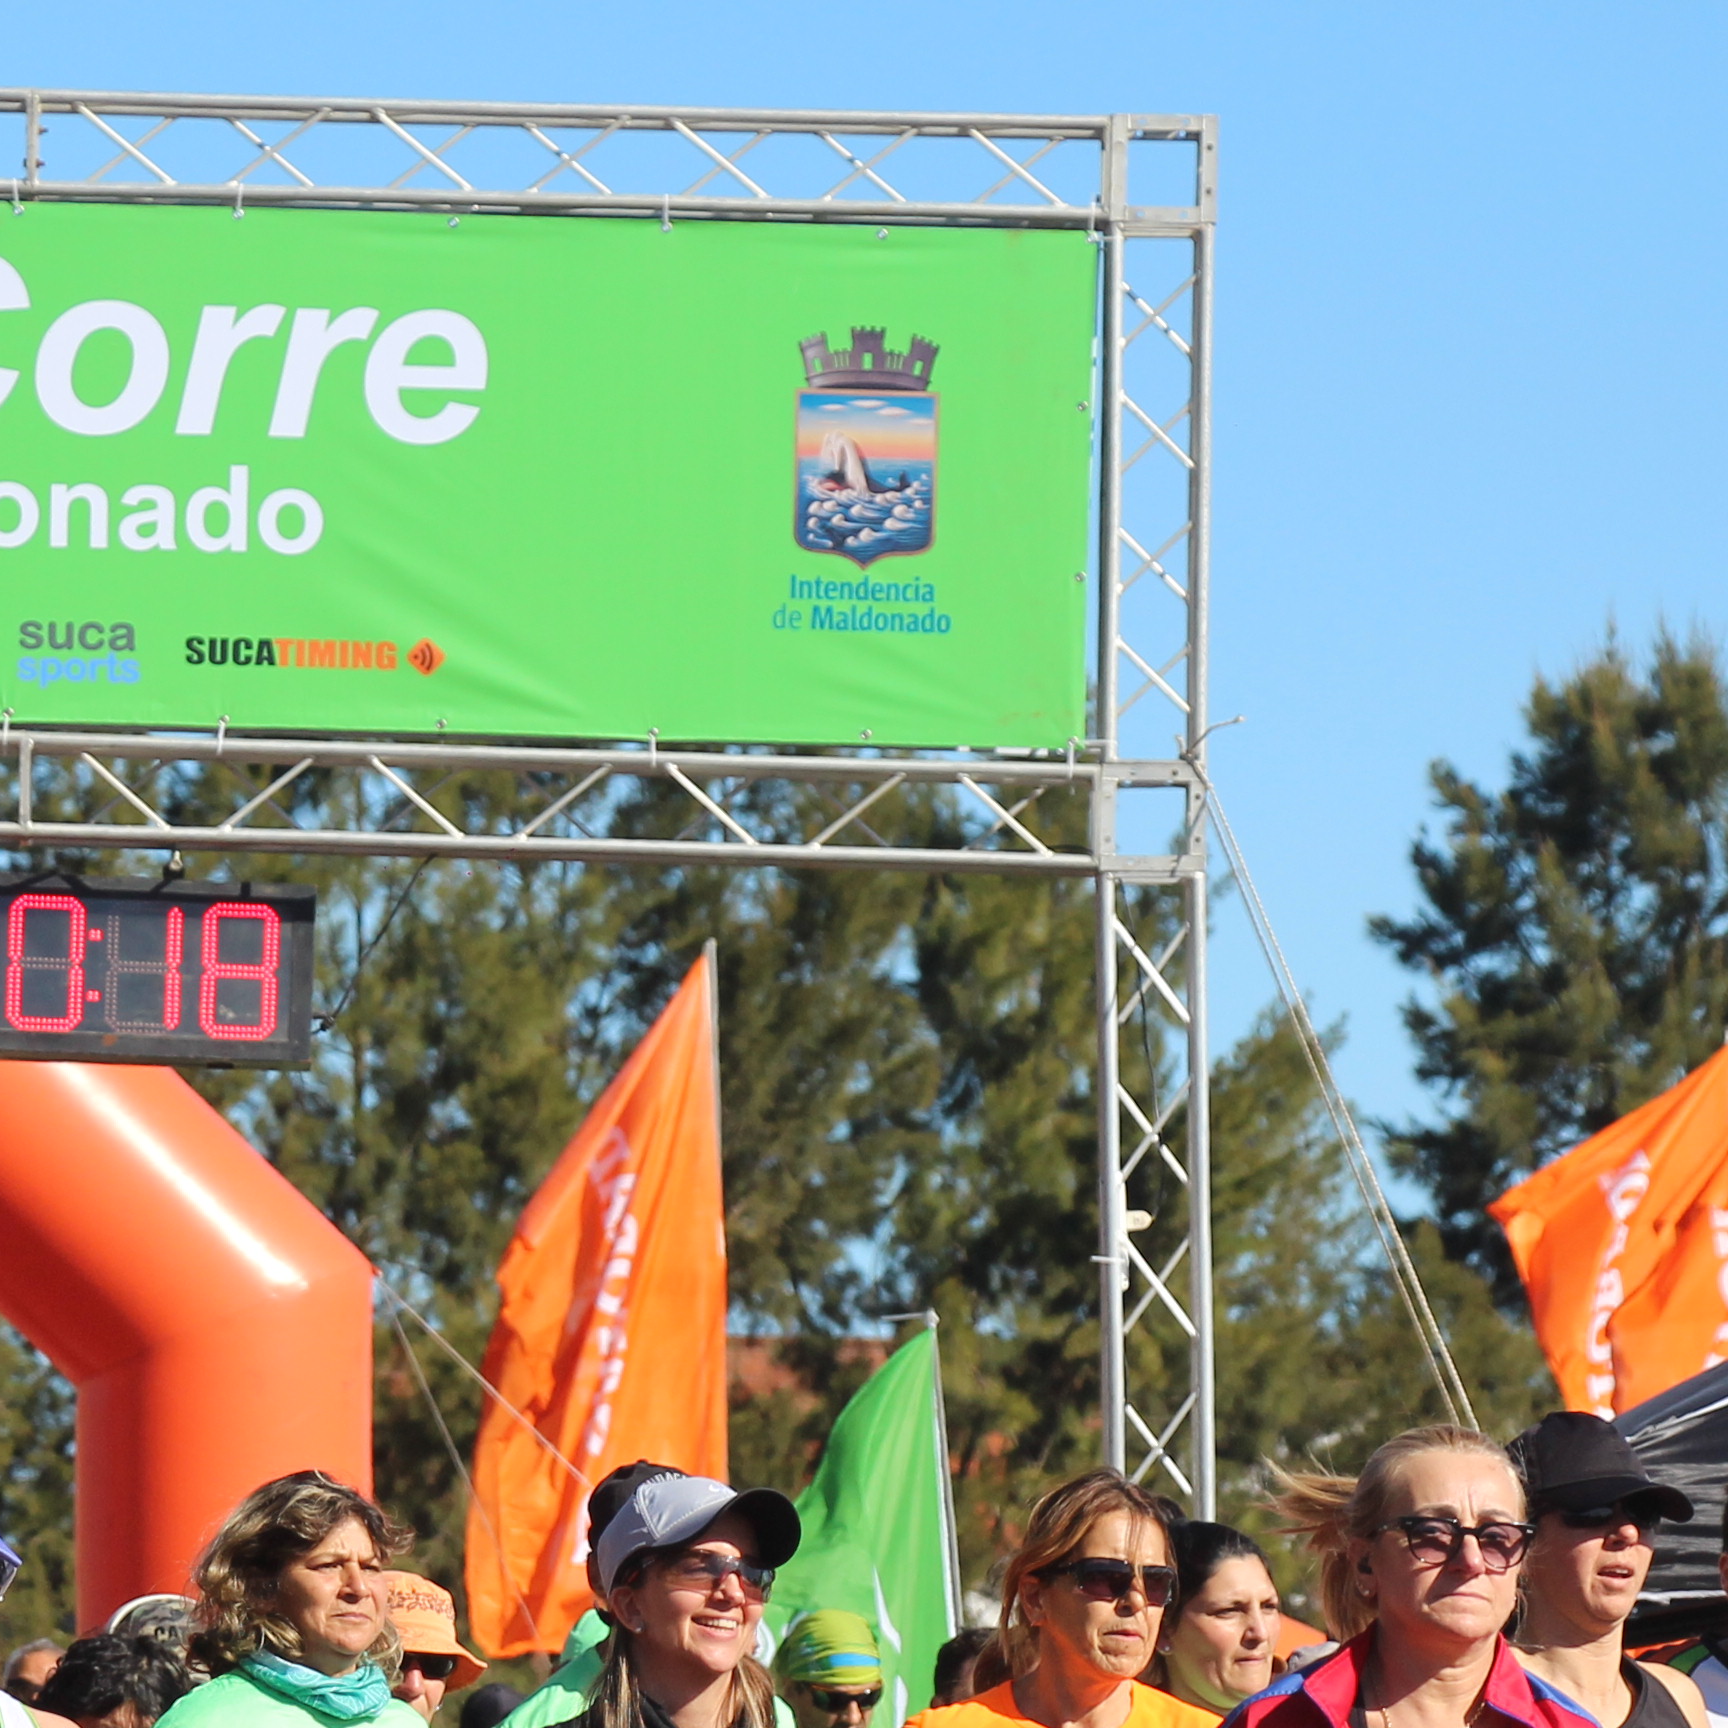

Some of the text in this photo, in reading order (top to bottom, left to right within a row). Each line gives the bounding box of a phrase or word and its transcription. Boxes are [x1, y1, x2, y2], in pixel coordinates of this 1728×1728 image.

[789, 574, 936, 603] Intendencia
[19, 619, 136, 651] suca
[772, 605, 952, 634] de Maldonado
[185, 636, 398, 670] SUCATIMING
[17, 652, 141, 688] sports
